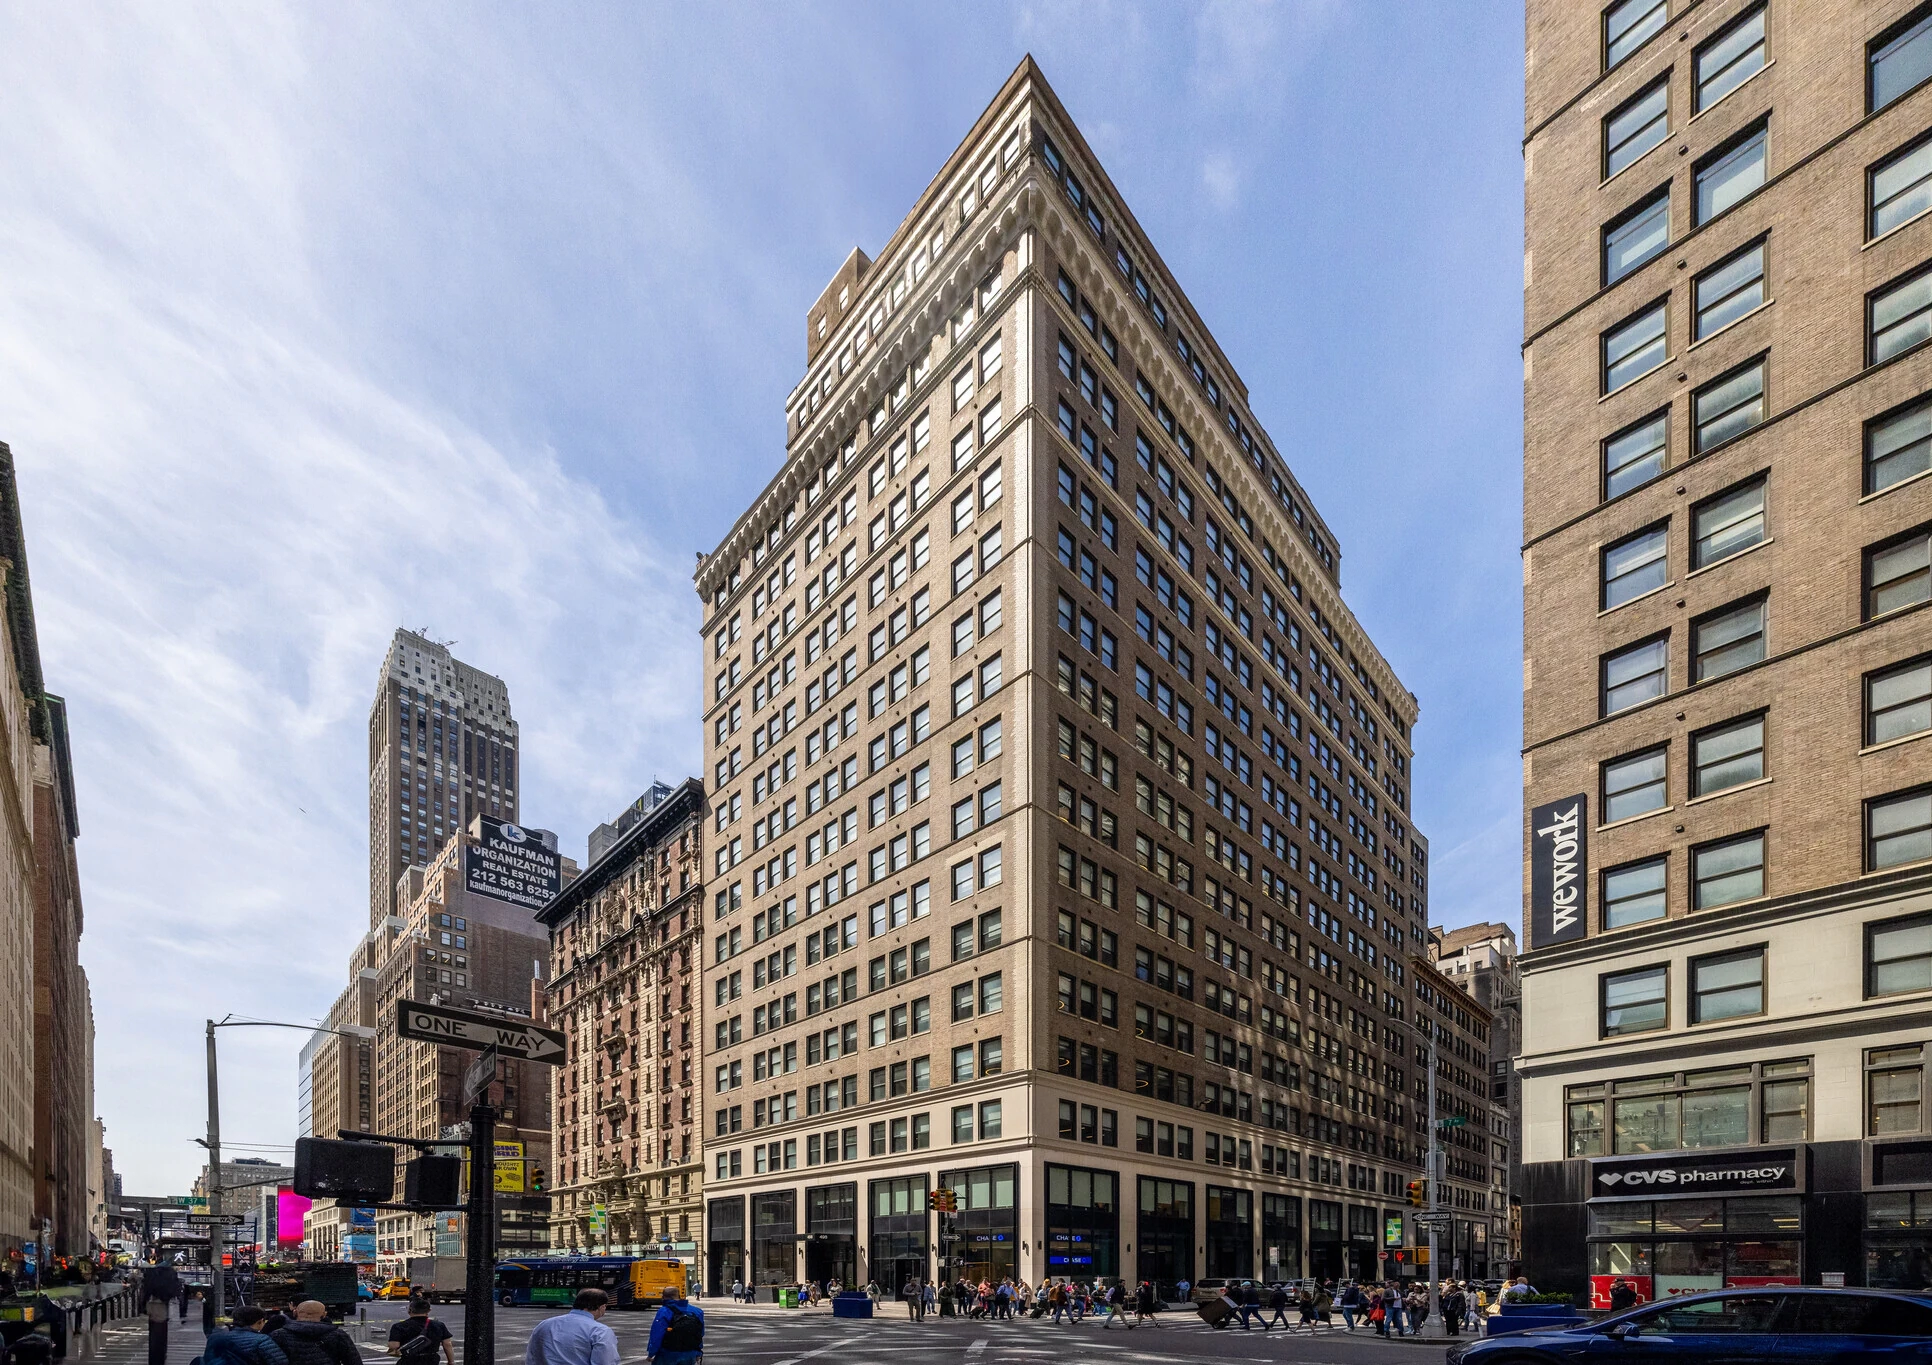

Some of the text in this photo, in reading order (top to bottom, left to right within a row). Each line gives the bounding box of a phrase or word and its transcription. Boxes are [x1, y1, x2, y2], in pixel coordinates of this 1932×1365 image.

[472, 846, 556, 879] ORGANIZATION
[489, 837, 554, 867] KAUFMAN
[482, 860, 548, 887] REAL ESTATE
[1537, 803, 1578, 934] wework
[472, 868, 556, 900] 212 563 6252
[415, 1015, 467, 1037] ONE
[496, 1030, 545, 1051] WAY
[1623, 1166, 1786, 1185] CVS pharmacy
[976, 1234, 997, 1242] CHAE
[1056, 1234, 1076, 1242] CHAE
